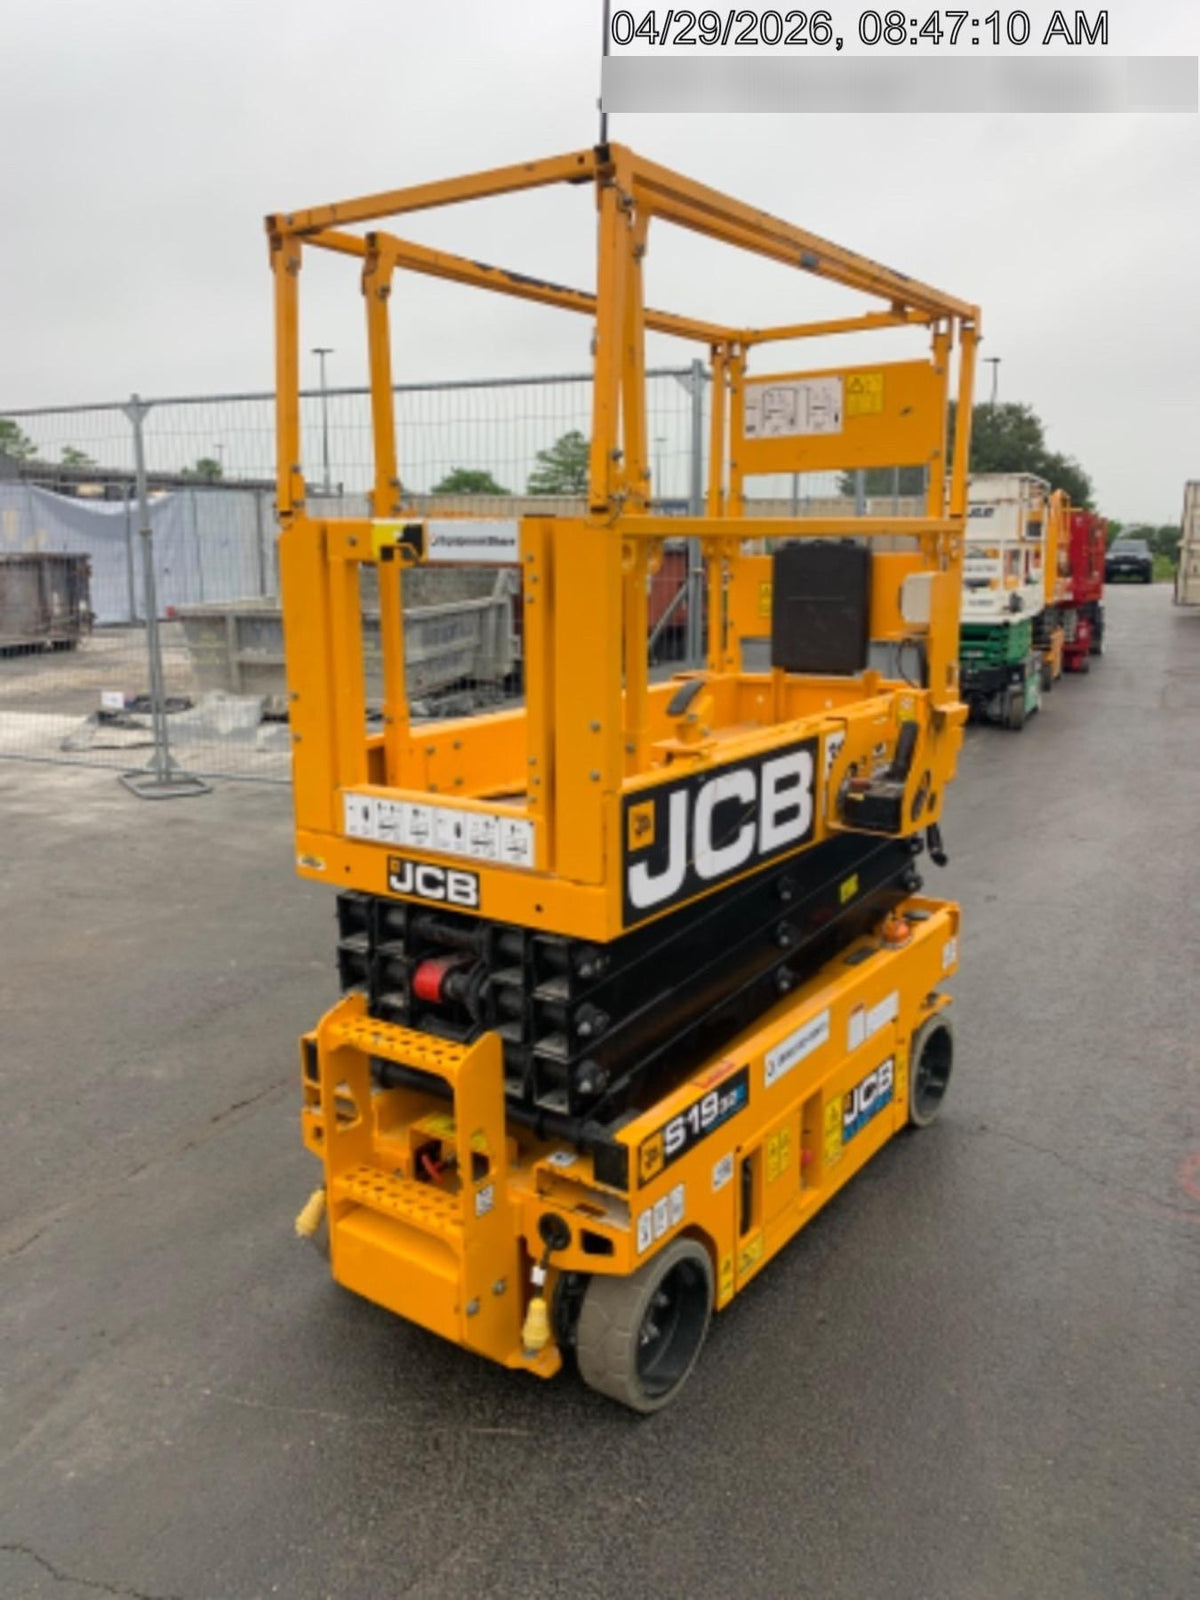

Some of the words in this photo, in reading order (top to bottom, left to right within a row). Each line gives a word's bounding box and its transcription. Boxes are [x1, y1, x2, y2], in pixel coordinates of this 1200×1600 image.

[628, 750, 814, 909] JCB
[389, 862, 478, 906] JCB
[843, 1058, 893, 1125] JCB
